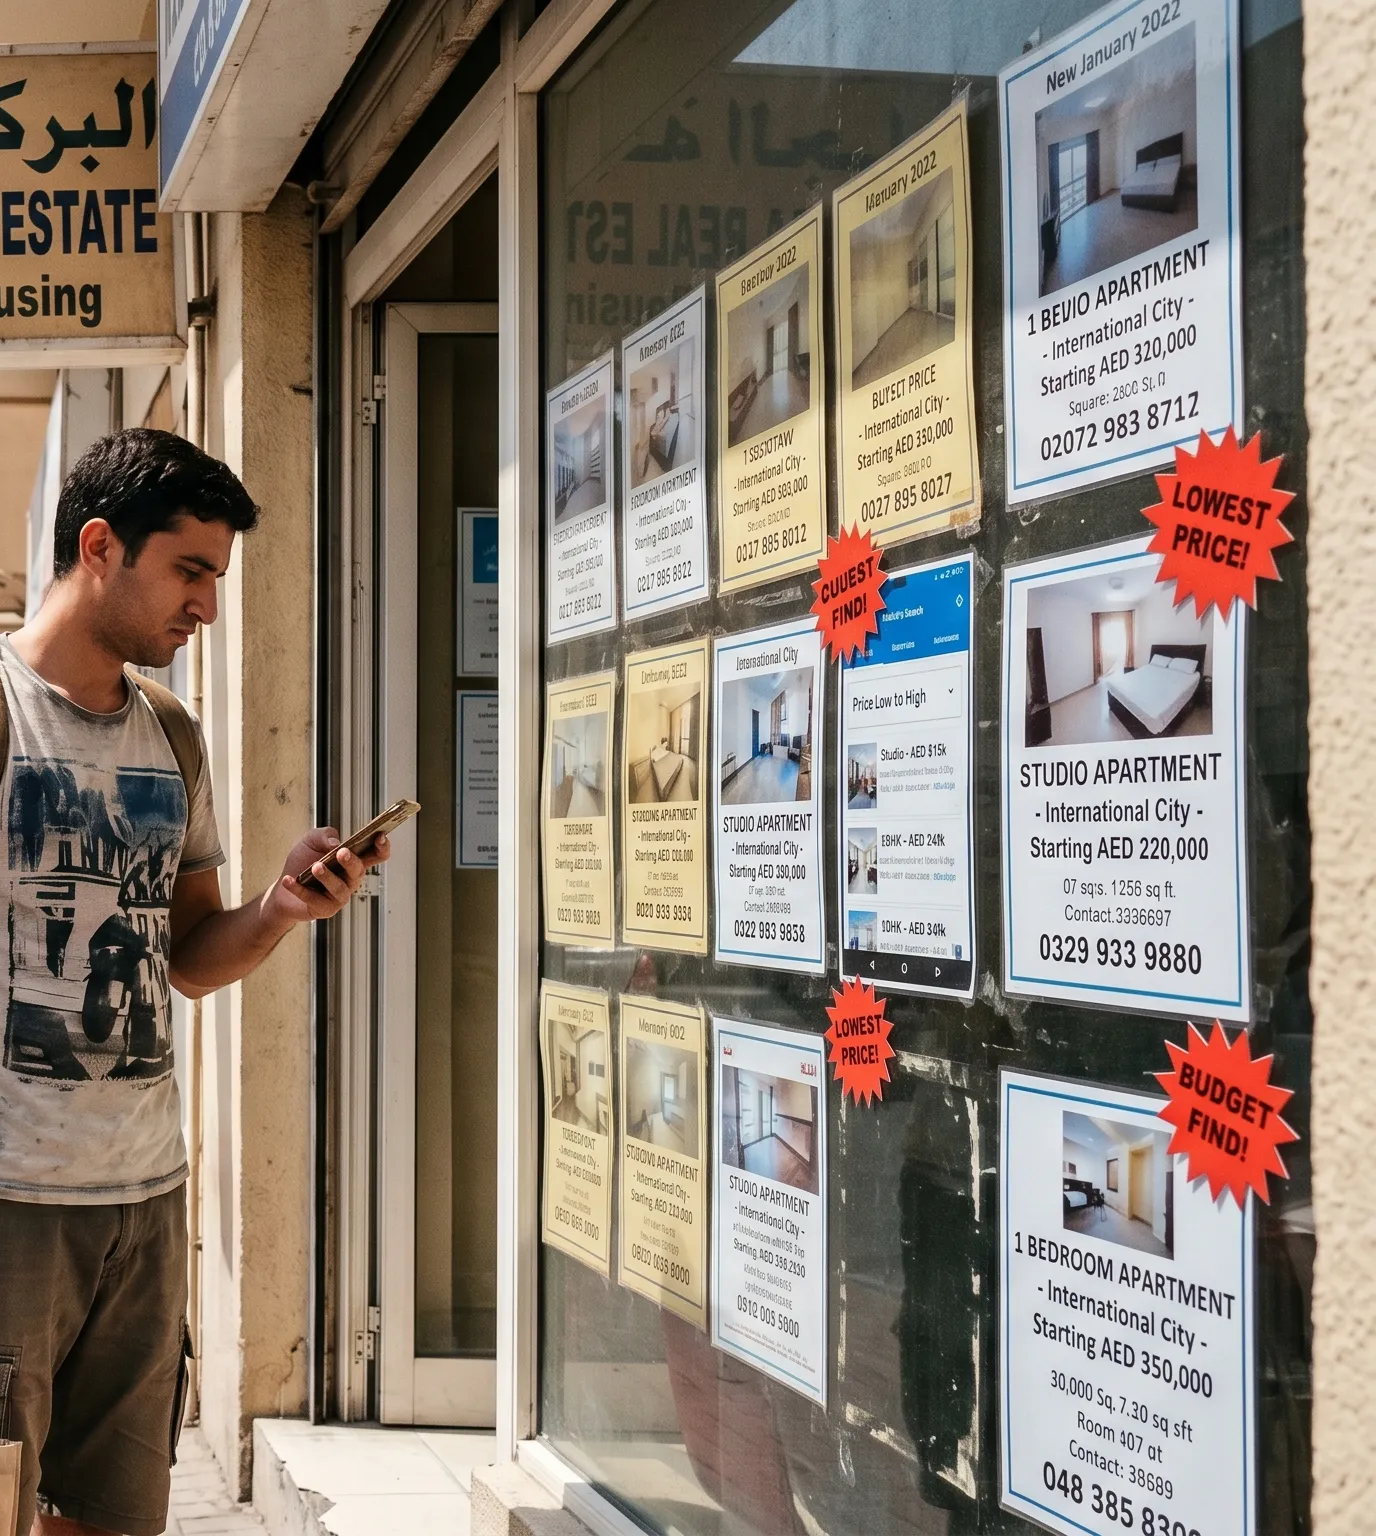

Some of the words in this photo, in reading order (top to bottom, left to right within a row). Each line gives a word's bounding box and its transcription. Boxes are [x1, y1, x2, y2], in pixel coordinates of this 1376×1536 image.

[1046, 66, 1077, 94] New
[1081, 26, 1137, 75] January
[1141, 0, 1181, 39] 2022
[911, 150, 937, 184] 2022
[3, 189, 158, 255] ESTATE
[1028, 314, 1036, 336] 1
[1095, 240, 1209, 310] APARTMENT
[1052, 305, 1147, 360] International
[1153, 297, 1183, 322] City
[1041, 364, 1095, 396] Starting
[1100, 348, 1129, 377] AED
[1134, 324, 1196, 366] 320,000
[909, 364, 936, 393] PRICE
[865, 400, 922, 440] International
[925, 395, 943, 414] City
[1069, 392, 1109, 416] Square:
[1041, 423, 1097, 460] 02072
[1104, 410, 1140, 443] 983
[1147, 391, 1199, 430] 8712
[786, 455, 801, 472] City
[857, 446, 893, 470] Starting
[895, 434, 913, 457] AED
[761, 487, 776, 507] AED
[862, 494, 890, 522] 0027
[894, 485, 916, 512] 895
[921, 472, 952, 502] 8027
[1172, 482, 1271, 529] LOWEST
[782, 523, 807, 548] 8012
[1172, 525, 1250, 570] PRICE!
[832, 592, 867, 630] FIND!
[783, 647, 798, 665] City
[853, 697, 873, 712] Price
[875, 694, 892, 709] Low
[894, 693, 903, 707] to
[906, 688, 926, 708] High
[881, 748, 904, 761] Studio
[910, 745, 926, 758] AED
[1020, 760, 1088, 787] STUDIO
[1093, 753, 1221, 784] APARTMENT
[756, 813, 812, 832] APARTMENT
[1046, 799, 1149, 823] International
[1155, 798, 1190, 827] City
[736, 841, 782, 856] International
[784, 841, 799, 859] City
[908, 834, 924, 846] AED
[1030, 837, 1092, 864] Starting
[1097, 837, 1133, 859] AED
[1139, 837, 1209, 864] 220,000
[729, 864, 756, 882] Starting
[758, 865, 773, 878] AED
[1063, 879, 1077, 894] 07
[1111, 880, 1141, 896] 1256
[1146, 884, 1160, 901] sq
[1164, 881, 1176, 898] ft.
[734, 920, 755, 938] 0322
[759, 922, 776, 940] 983
[909, 922, 924, 935] AED
[1040, 934, 1089, 963] 0329
[1097, 937, 1136, 968] 933
[1145, 941, 1202, 974] 9880
[835, 1014, 881, 1038] LOWEST
[842, 1044, 879, 1065] PRICE!
[1179, 1062, 1273, 1129] BUDGET
[1187, 1108, 1250, 1162] FIND!
[760, 1186, 809, 1217] APARTMENT
[1015, 1232, 1023, 1254] 1
[1028, 1235, 1113, 1281] BEDROOM
[1119, 1263, 1235, 1320] APARTMENT
[1048, 1279, 1155, 1336] International
[1161, 1318, 1195, 1354] City
[1033, 1312, 1096, 1360] Starting
[1101, 1337, 1135, 1368] AED
[1141, 1351, 1212, 1398] 350,000
[1051, 1370, 1092, 1402] 30,000
[1097, 1388, 1115, 1413] Sq.
[1153, 1412, 1169, 1438] sq
[1174, 1421, 1193, 1443] sft
[1077, 1411, 1115, 1443] Room
[1070, 1439, 1124, 1478] Contact:
[1129, 1465, 1173, 1499] 38689
[1043, 1461, 1083, 1504] 048
[1092, 1484, 1133, 1529] 385
